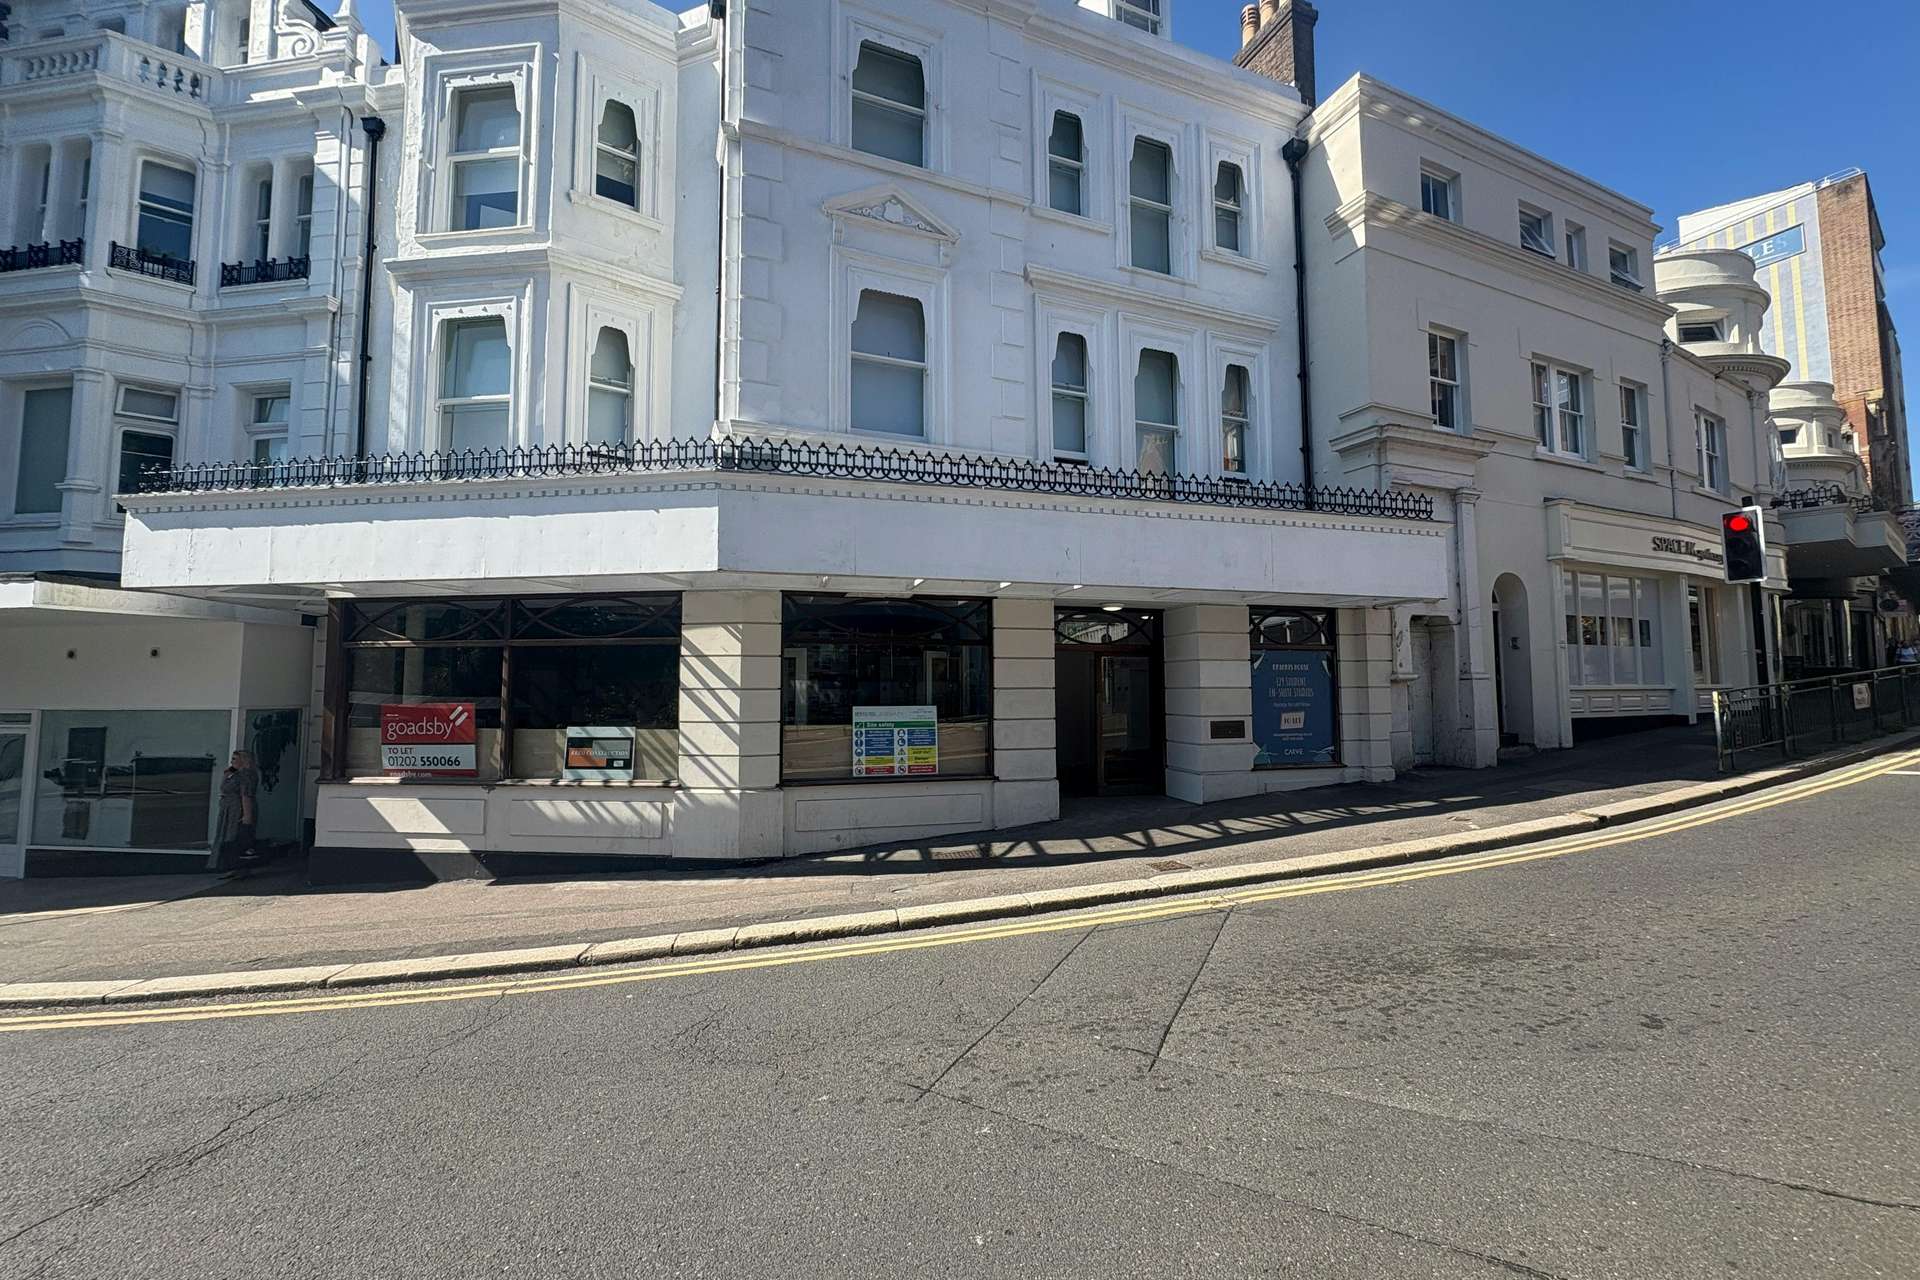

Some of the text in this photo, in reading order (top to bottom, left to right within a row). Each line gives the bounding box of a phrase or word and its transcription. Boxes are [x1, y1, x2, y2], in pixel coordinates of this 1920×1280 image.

[387, 716, 453, 740] goadsby
[387, 747, 413, 755] TO LET
[387, 755, 461, 767] 01202 550066
